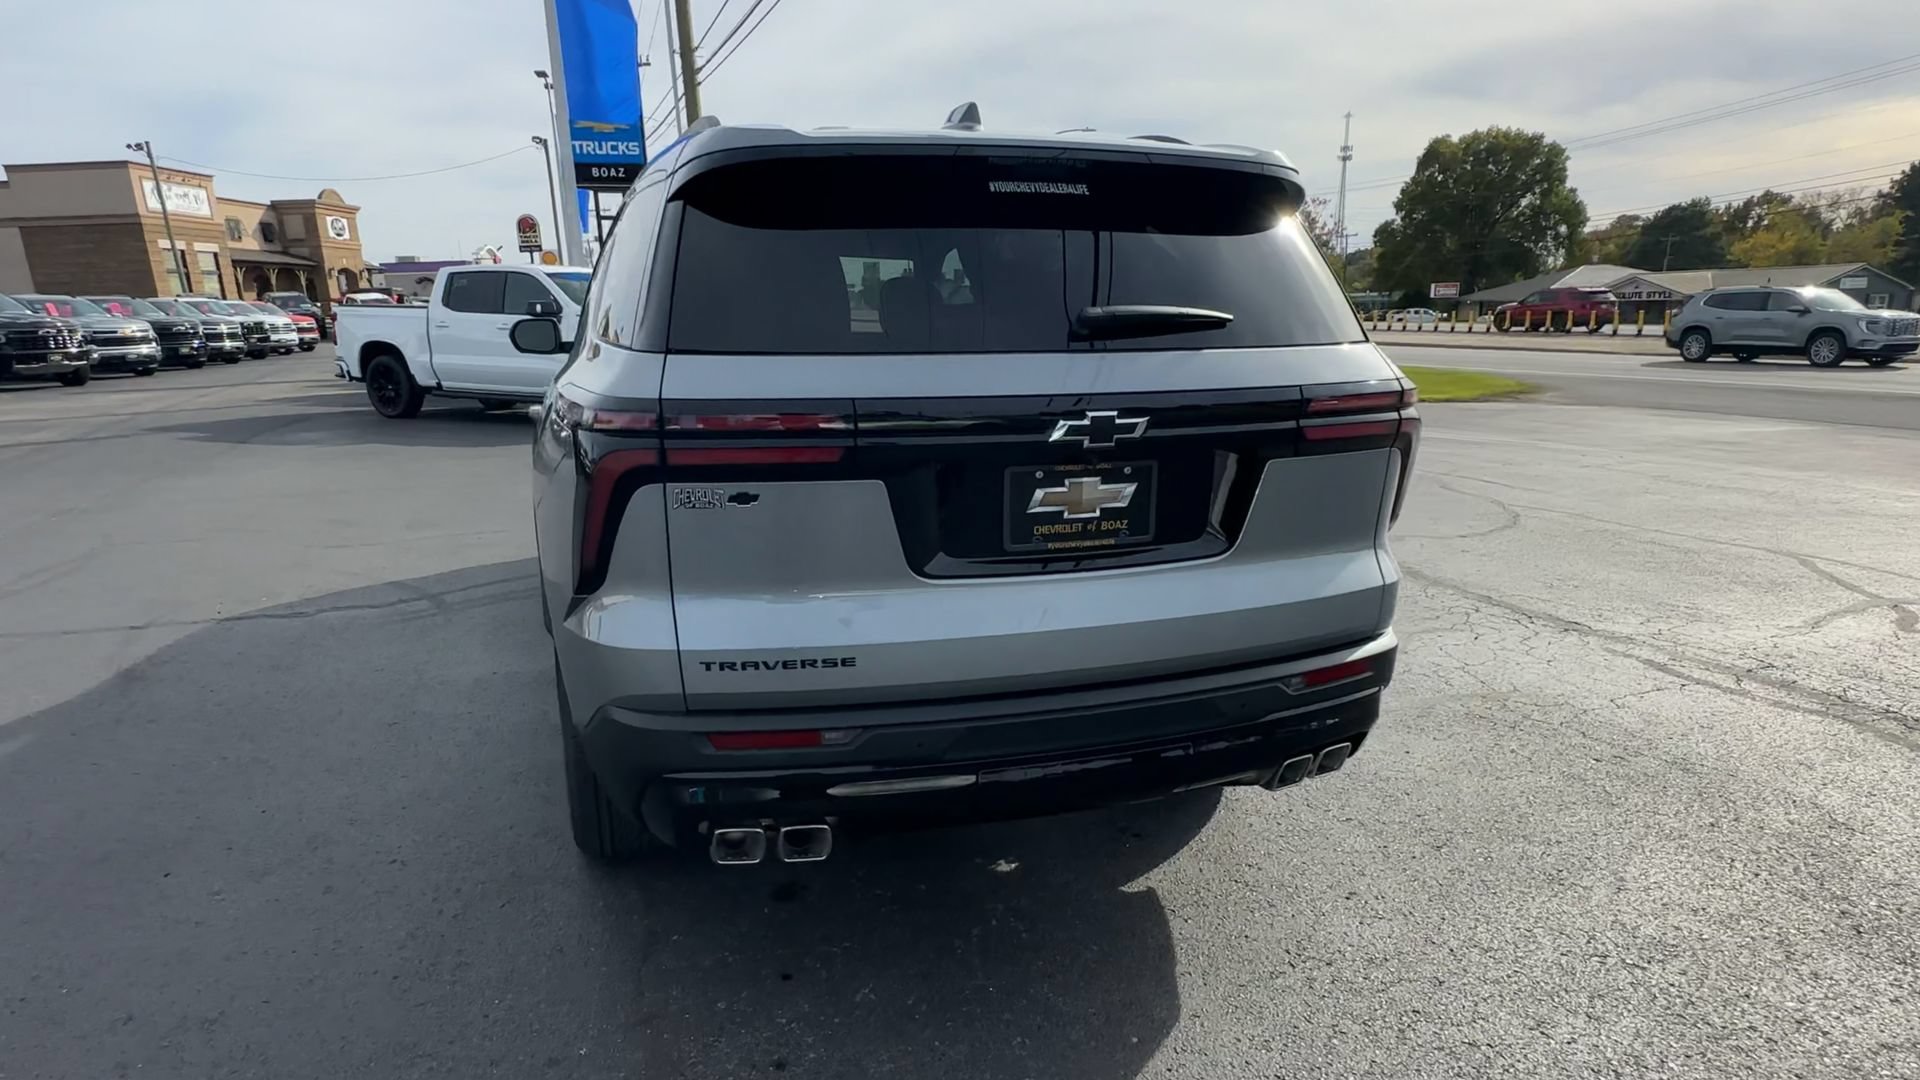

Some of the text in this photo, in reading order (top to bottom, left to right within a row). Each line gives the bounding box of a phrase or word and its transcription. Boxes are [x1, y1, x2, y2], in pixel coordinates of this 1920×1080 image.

[572, 140, 640, 155] TRUCKS
[592, 167, 625, 178] BOAZ
[673, 488, 724, 509] CHEVROLET
[1033, 520, 1129, 535] CHEVROLET of BOAZ
[699, 657, 857, 671] TRAVERSE
